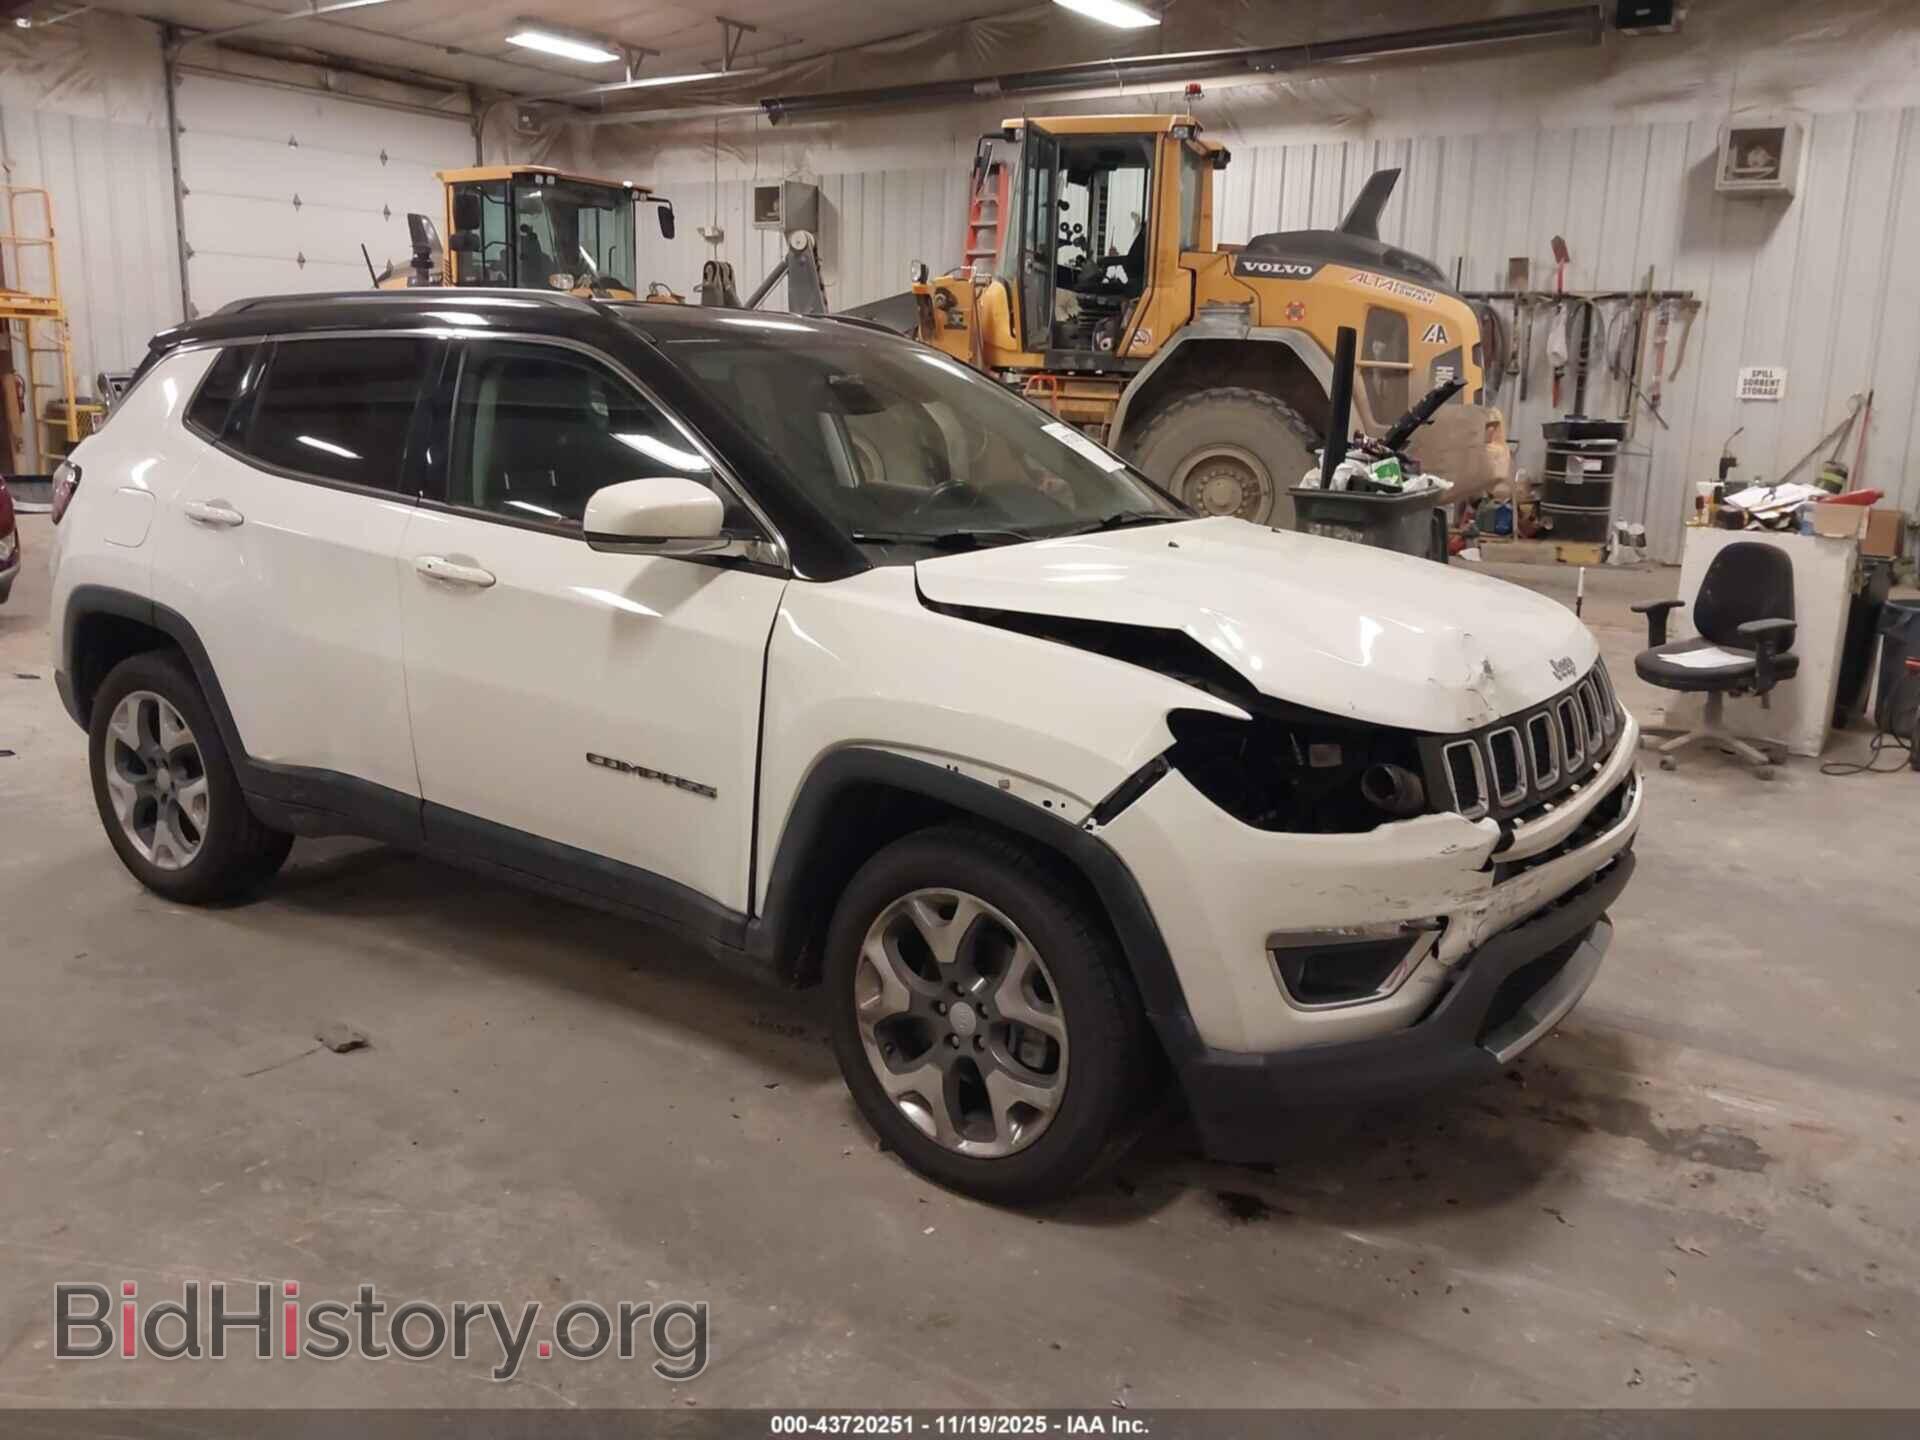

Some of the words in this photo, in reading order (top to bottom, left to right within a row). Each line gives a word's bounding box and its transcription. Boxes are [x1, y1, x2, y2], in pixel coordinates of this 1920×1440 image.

[1243, 262, 1313, 275] VOLVO
[1350, 272, 1394, 291] ALTA
[1752, 369, 1774, 378] SPILL
[1743, 378, 1781, 387] SORBENT
[1741, 387, 1778, 396] STORAGE
[1549, 656, 1577, 681] Jeep
[586, 752, 717, 799] COMPASS
